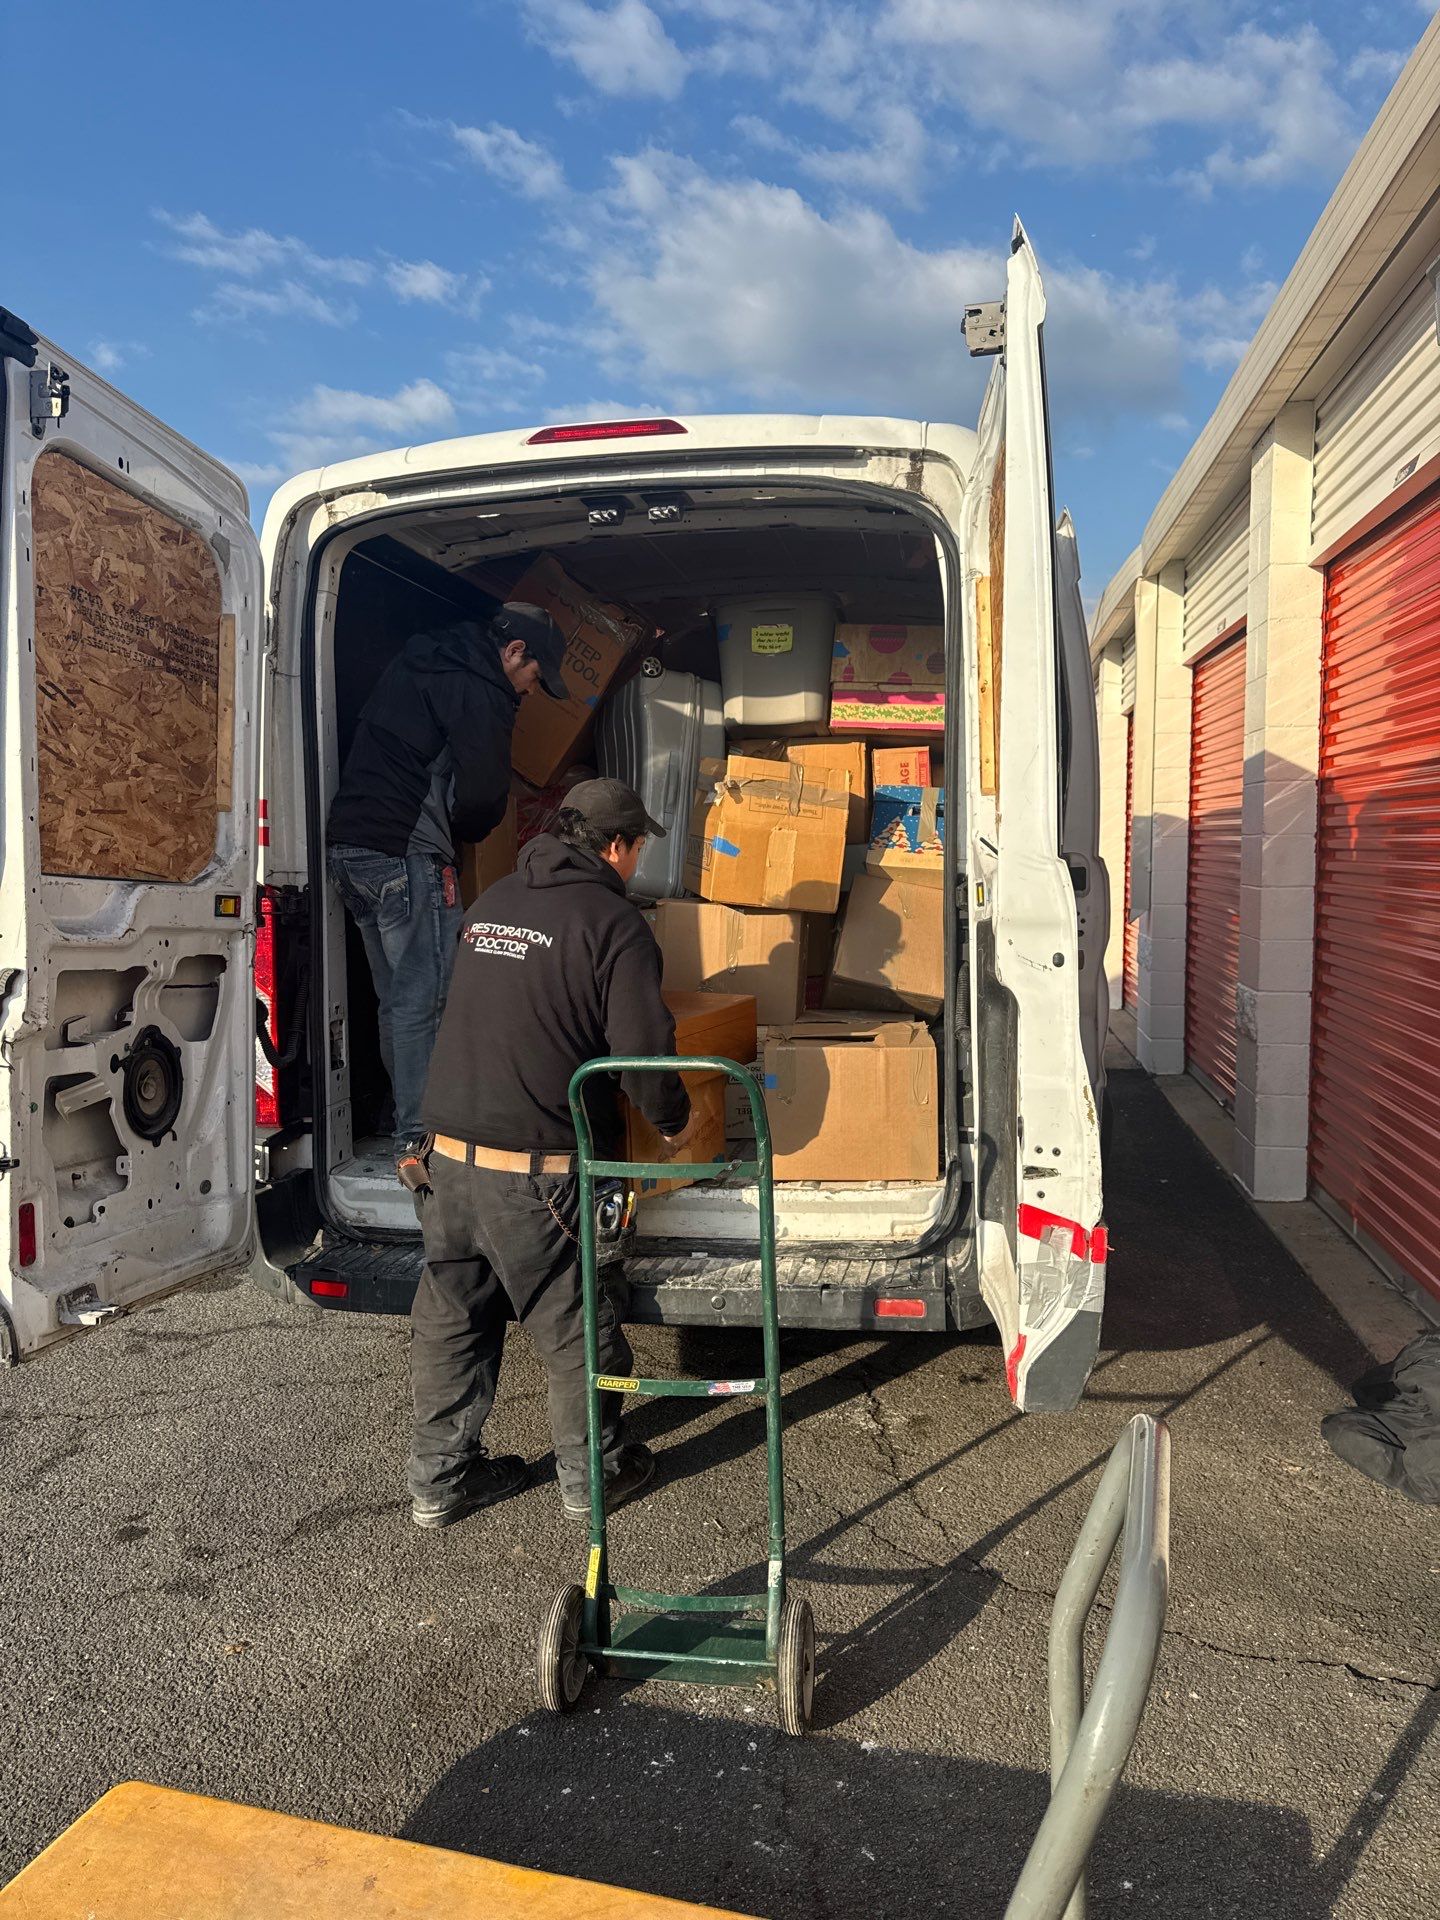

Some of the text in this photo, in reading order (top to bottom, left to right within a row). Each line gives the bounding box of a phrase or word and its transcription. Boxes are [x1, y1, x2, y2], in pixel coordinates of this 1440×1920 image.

[565, 651, 600, 688] TOOL
[470, 922, 553, 948] RESTORATION
[476, 936, 528, 955] DOCTOR
[600, 1379, 637, 1390] HARPER
